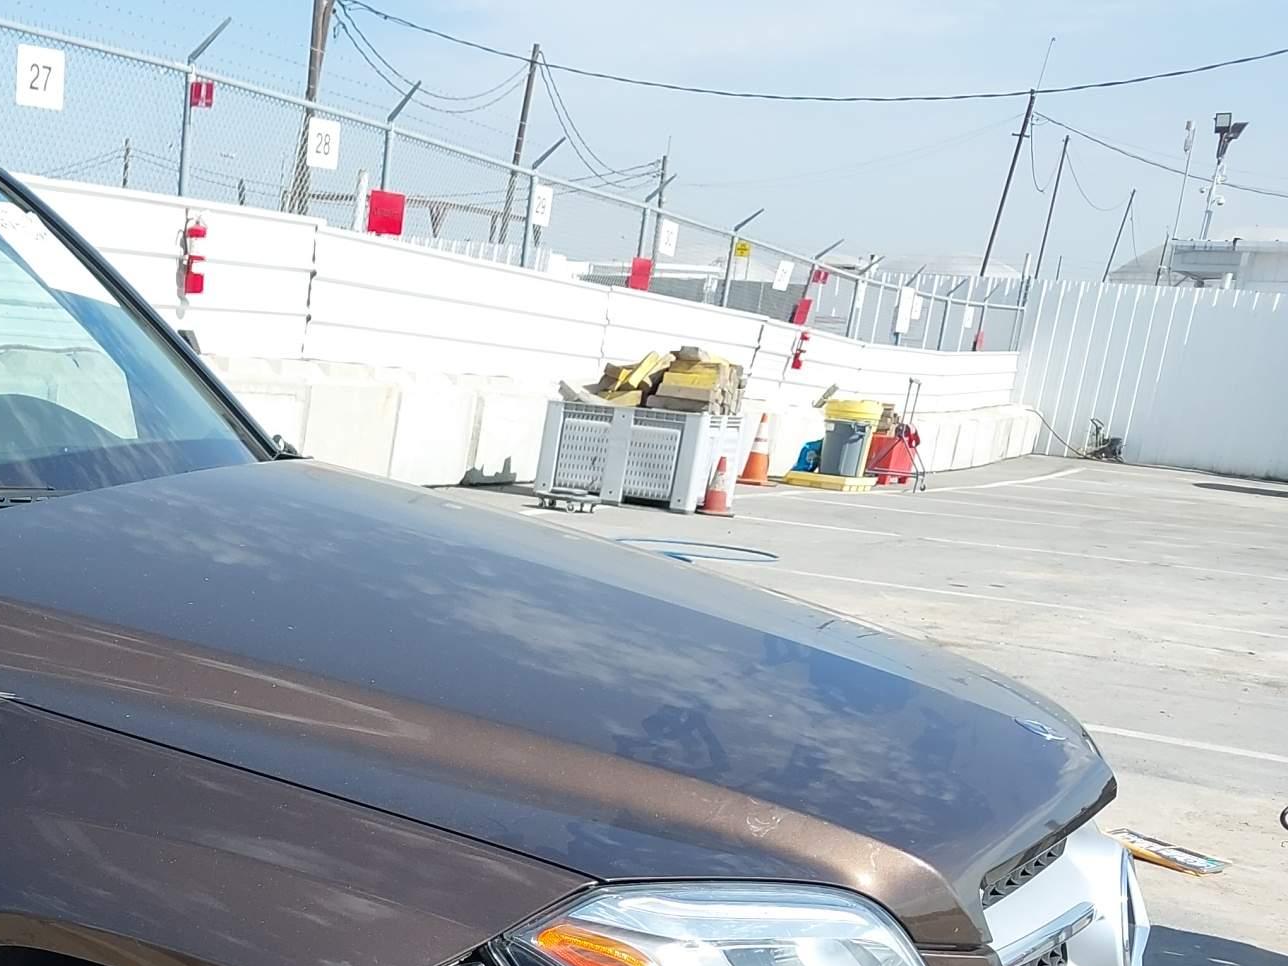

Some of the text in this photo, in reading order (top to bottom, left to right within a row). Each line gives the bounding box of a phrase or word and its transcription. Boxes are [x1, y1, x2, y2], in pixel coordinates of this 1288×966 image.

[29, 63, 52, 92] 27
[315, 132, 331, 156] 28
[535, 195, 547, 215] 29
